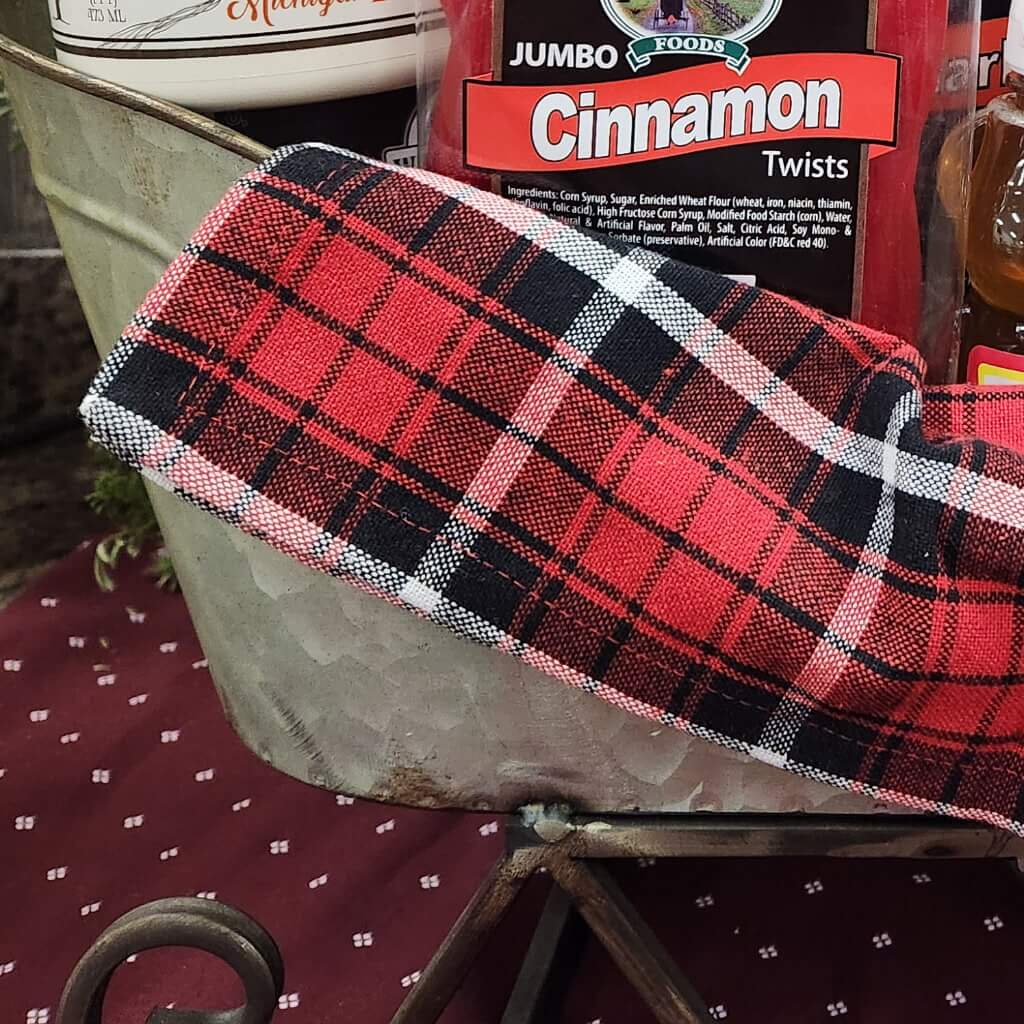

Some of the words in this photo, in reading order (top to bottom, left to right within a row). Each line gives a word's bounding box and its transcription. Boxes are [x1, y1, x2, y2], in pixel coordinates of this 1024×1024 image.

[509, 41, 619, 70] JUMBO
[655, 36, 725, 54] FOODS
[530, 78, 842, 164] Cinnamon
[761, 150, 849, 179] Twists
[507, 184, 558, 200] Ingredients:
[560, 190, 579, 202] Corn
[581, 192, 608, 206] Syrup,
[610, 193, 638, 207] Sugar,
[639, 194, 677, 206] Enriched
[678, 194, 707, 206] Wheat
[708, 195, 731, 207] Flour
[732, 195, 765, 209] (wheat,
[766, 196, 786, 209] iron,
[788, 197, 816, 210] niacin,
[817, 197, 853, 211] thiamin,
[553, 201, 571, 213] folic
[597, 204, 617, 218] High
[619, 206, 656, 218] Fructose
[657, 207, 677, 219] Corn
[679, 208, 705, 222] Syrup,
[706, 209, 746, 221] Modified
[747, 210, 768, 222] Food
[769, 210, 796, 222] Starch
[797, 211, 825, 224] (corn),
[826, 211, 853, 224] Water,
[596, 219, 633, 230] Artificial
[638, 221, 666, 233] Flavor,
[671, 221, 693, 233] Palm
[698, 222, 712, 234] Oil,
[717, 222, 736, 234] Salt,
[740, 223, 762, 234] Citric
[766, 223, 787, 235] Acid,
[792, 223, 808, 237] Soy
[812, 224, 840, 235] Mono-
[844, 225, 852, 236] &
[643, 233, 705, 247] (preservative),
[706, 236, 744, 247] Artificial
[745, 236, 767, 248] Color
[769, 237, 795, 249] (FD&C
[797, 238, 811, 249] red
